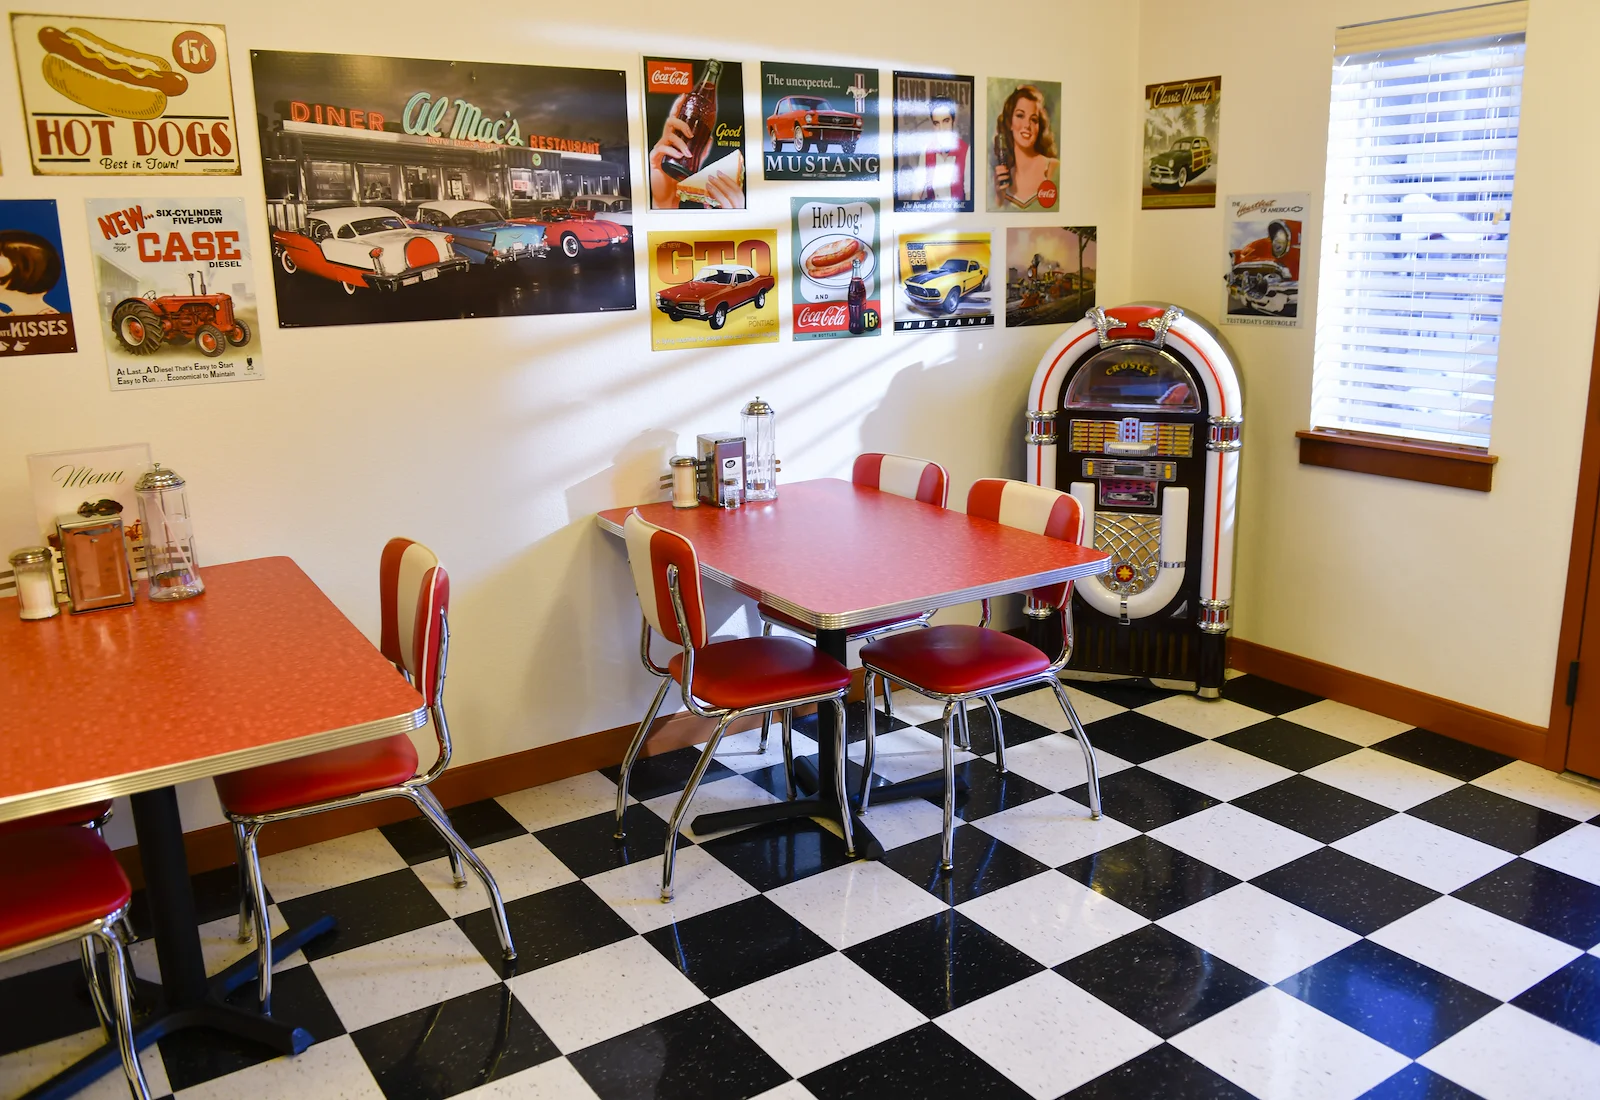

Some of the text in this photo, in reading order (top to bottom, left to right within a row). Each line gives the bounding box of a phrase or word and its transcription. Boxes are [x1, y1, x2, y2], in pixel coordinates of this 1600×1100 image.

[179, 39, 210, 65] 15¢
[652, 70, 689, 85] Coca-Cola
[766, 74, 841, 90] The unexpected...
[899, 79, 926, 102] ELVIS
[1154, 81, 1211, 108] Classic Woody
[290, 101, 385, 132] DINER
[402, 91, 524, 146] Al Mac's
[36, 119, 232, 157] HOT DOGS
[716, 123, 742, 140] Good
[530, 135, 601, 155] RESTAURANT
[100, 158, 179, 170] Best in Town!
[766, 155, 879, 173] MUSTANG
[156, 209, 222, 217] SIX-CYLINDER
[172, 217, 223, 225] FIVE-PLOW
[812, 207, 863, 235] Hot Dog!
[137, 231, 242, 263] CASE
[657, 240, 771, 285] GTO
[749, 319, 775, 327] PONTIAC
[798, 305, 848, 327] Coca-Cola
[903, 318, 986, 329] MUSTANG
[10, 320, 68, 338] KISSES
[116, 368, 125, 376] At
[153, 365, 174, 374] Diesel
[175, 364, 193, 372] That's
[194, 363, 210, 371] Easy
[218, 361, 234, 369] Start
[1105, 361, 1158, 377] CROSLEY
[117, 377, 133, 386] Easy
[167, 372, 202, 381] Economical
[209, 370, 236, 378] Maintain
[51, 464, 126, 489] Menu
